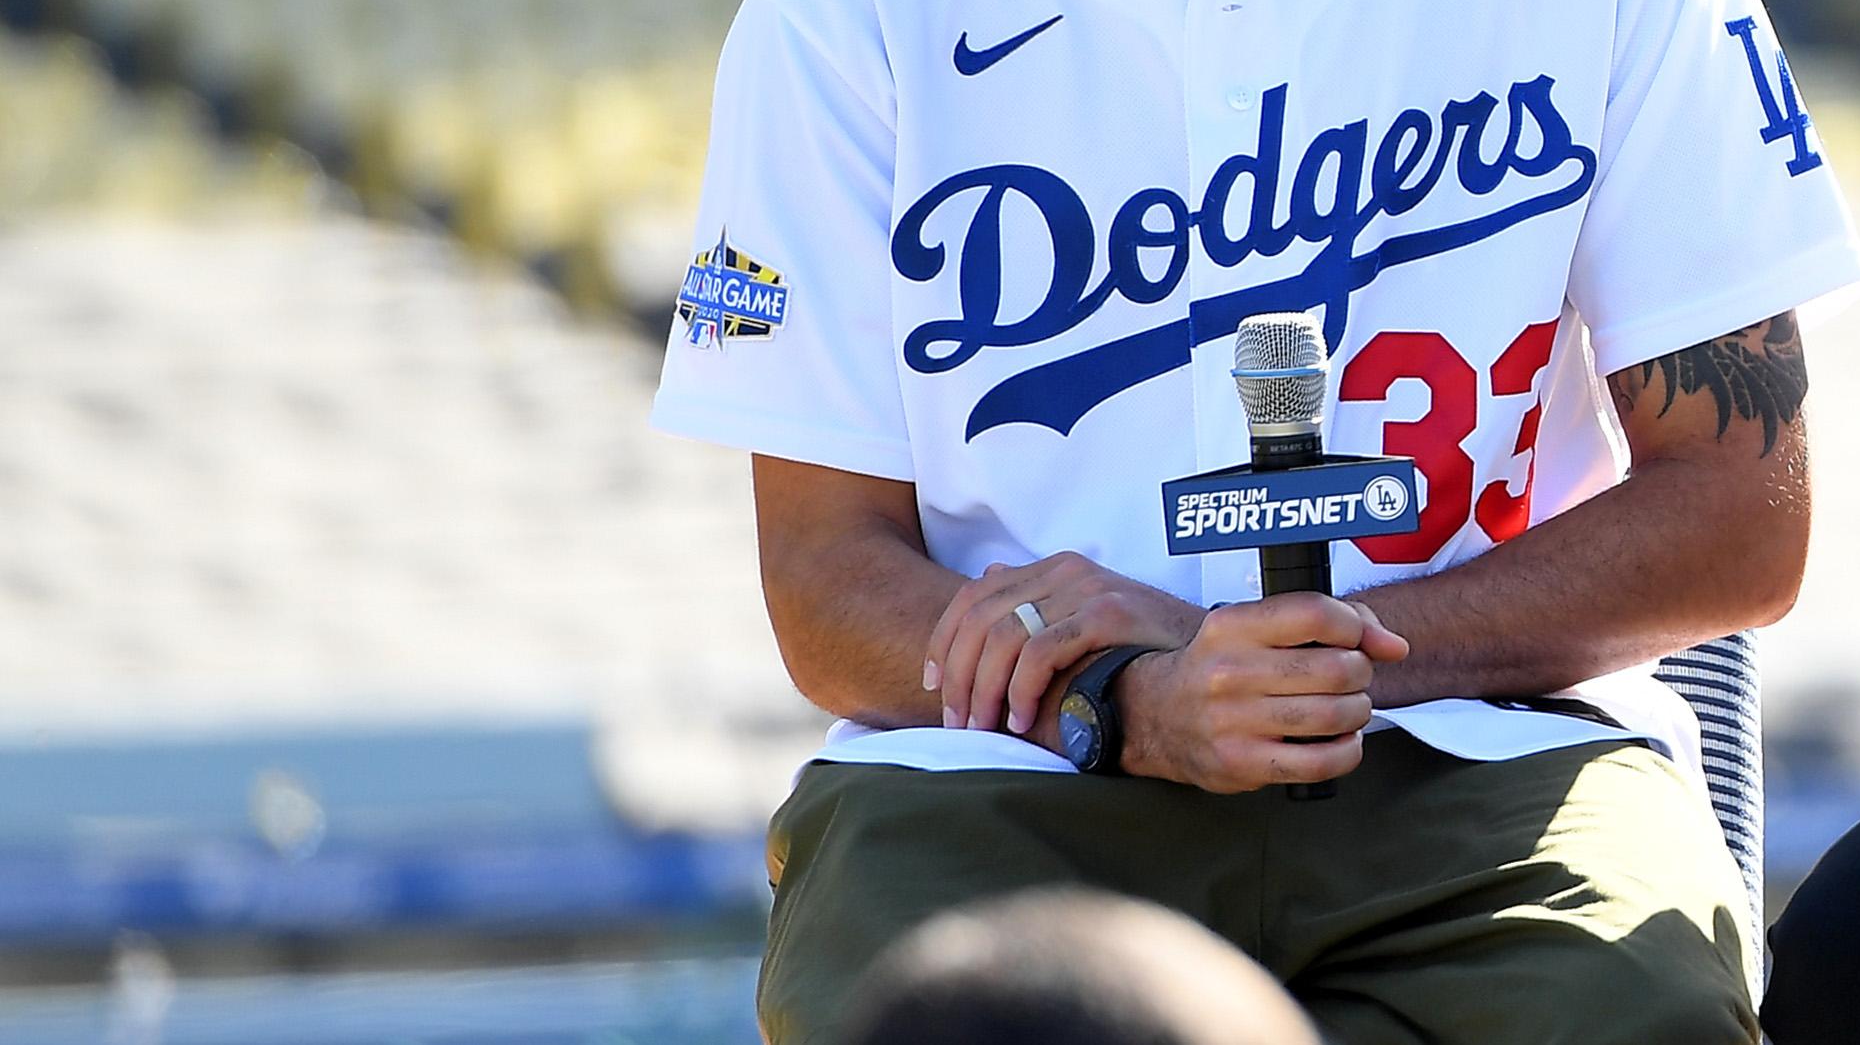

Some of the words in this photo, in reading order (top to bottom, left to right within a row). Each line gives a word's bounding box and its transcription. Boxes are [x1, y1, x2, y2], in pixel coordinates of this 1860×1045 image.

[891, 73, 1597, 444] Dodgers
[722, 278, 784, 317] GAME
[1339, 318, 1560, 565] 33
[1175, 493, 1363, 538] SPORTSNET
[1177, 487, 1268, 511] SPECTRUM
[1376, 484, 1397, 512] LA
